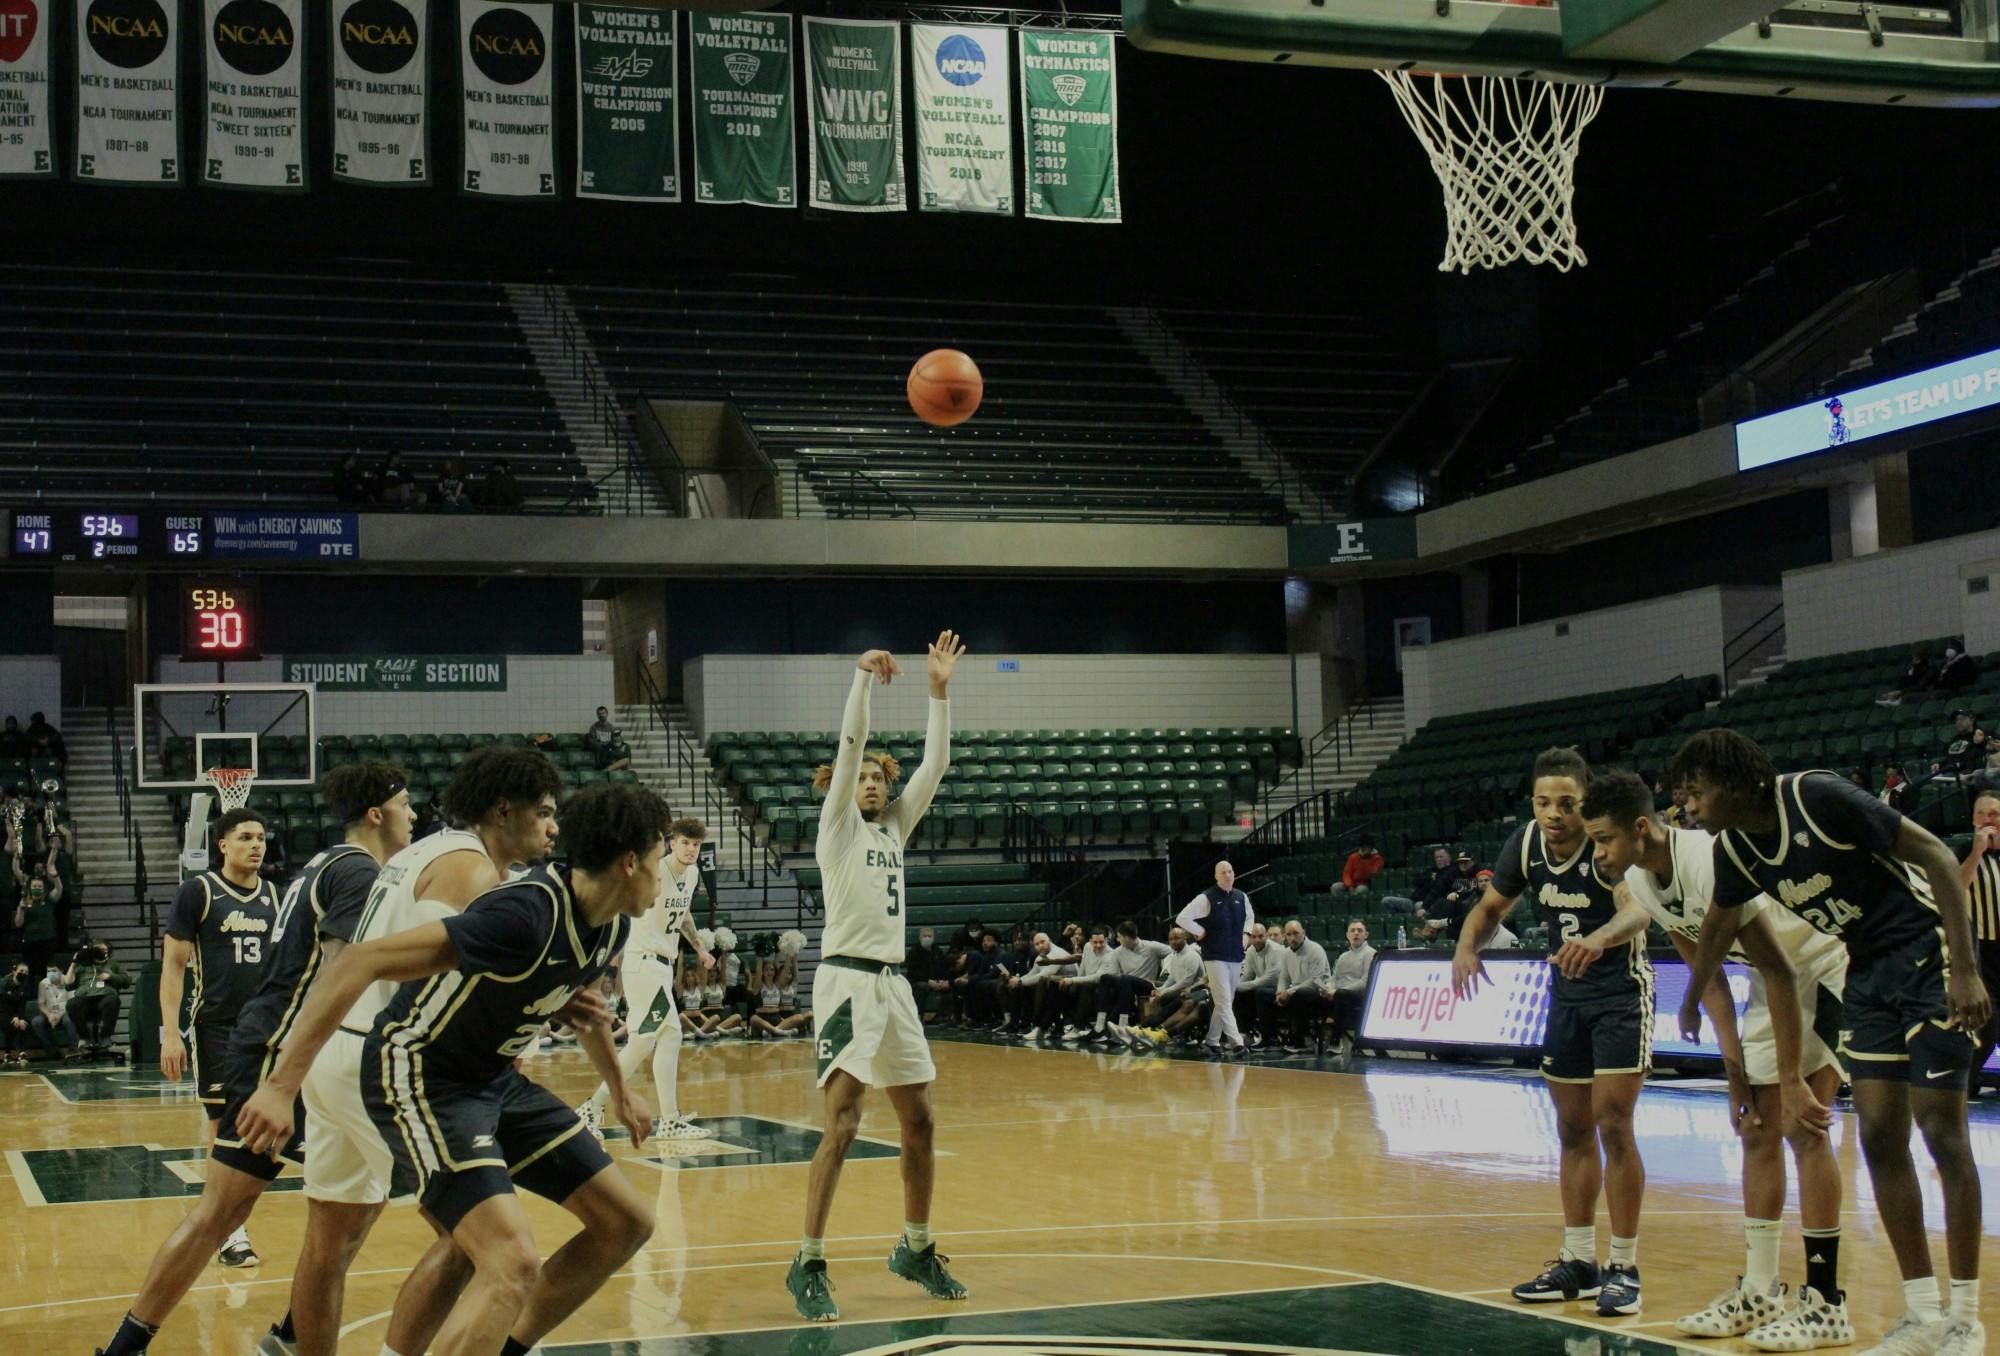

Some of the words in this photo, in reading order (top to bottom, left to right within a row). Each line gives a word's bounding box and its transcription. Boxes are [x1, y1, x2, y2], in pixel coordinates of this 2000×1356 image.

[91, 15, 164, 38] NCAA
[592, 10, 660, 27] WOMEN'S
[708, 17, 775, 35] WOMEN'S
[219, 24, 288, 45] NCAA
[344, 22, 413, 45] NCAA
[579, 26, 673, 46] VOLLEYBALL
[474, 33, 541, 56] NCAA
[695, 33, 787, 53] VOLLEYBALL
[1036, 39, 1097, 54] WOMEN'S
[832, 46, 873, 58] WOMEN'S
[826, 57, 879, 71] VOLLEYBALL
[941, 59, 985, 75] NCAA
[1026, 55, 1110, 71] GYMNASTICS
[81, 75, 110, 88] MEN'S
[114, 78, 173, 91] BASKETBALL
[209, 80, 236, 95] MEN'S
[241, 85, 298, 98] BASKETBALL
[335, 78, 362, 92] MEN'S
[367, 83, 422, 96] BASKETBALL
[583, 82, 617, 96] WEST
[621, 86, 673, 99] DIVISION
[466, 90, 492, 103] MEN'S
[496, 93, 549, 106] BASKETBALL
[594, 99, 662, 112] CHAMPIONS
[702, 89, 784, 105] TOURNAMENT
[820, 86, 887, 122] WIVC
[933, 95, 993, 109] WOMEN'S
[83, 106, 106, 118] NCAA
[111, 108, 172, 121] TOURNAMENT
[211, 103, 233, 117] NCAA
[238, 107, 296, 119] TOURNAMENT
[336, 108, 358, 122] NCAA
[364, 112, 421, 125] TOURNAMENT
[710, 103, 777, 118] CHAMPIONS
[922, 110, 1005, 125] VOLLEYBALL
[1031, 107, 1110, 125] CHAMPIONS
[468, 119, 489, 133] NCAA
[494, 122, 549, 136] TOURNAMENT
[611, 117, 646, 131] 2005
[726, 122, 761, 137] 2018
[819, 120, 893, 140] TOURNAMENT
[1033, 123, 1066, 137] 2007
[945, 132, 984, 146] NCAA
[35, 151, 48, 170] E
[925, 146, 1005, 160] TOURNAMENT
[80, 154, 95, 175] E
[161, 159, 175, 179] E
[208, 159, 222, 179] E
[335, 153, 348, 174] E
[409, 159, 423, 178] E
[1035, 156, 1067, 169] 2017
[285, 164, 300, 184] E
[466, 170, 481, 190] E
[582, 171, 595, 187] E
[1034, 172, 1067, 185] 2021
[539, 173, 553, 193] E
[663, 175, 675, 191] E
[700, 182, 714, 198] E
[776, 187, 790, 202] E
[885, 183, 898, 202] E
[925, 192, 937, 207] E
[997, 197, 1008, 211] E
[1896, 382, 1949, 414] TEAM
[1953, 374, 1981, 400] UP
[17, 515, 51, 528] HOME
[166, 517, 203, 530] GUEST
[214, 517, 236, 533] WIN
[238, 520, 257, 533] with
[259, 518, 297, 534] ENERGY
[300, 518, 342, 535] SAVINGS
[24, 531, 49, 549] 47
[174, 533, 199, 552] 65
[1337, 523, 1364, 555] E
[94, 542, 104, 557] 2
[106, 545, 137, 555] PERIOD
[320, 543, 353, 556] DTE
[200, 612, 242, 648] 30
[290, 663, 368, 682] STUDENT
[426, 663, 499, 682] SECTION
[887, 874, 899, 916] 5
[1802, 897, 1863, 935] 24
[1559, 913, 1583, 944] 2
[232, 937, 261, 963] 13
[1382, 973, 1462, 1032] meijer
[651, 1010, 663, 1022] E
[818, 1039, 832, 1060] E
